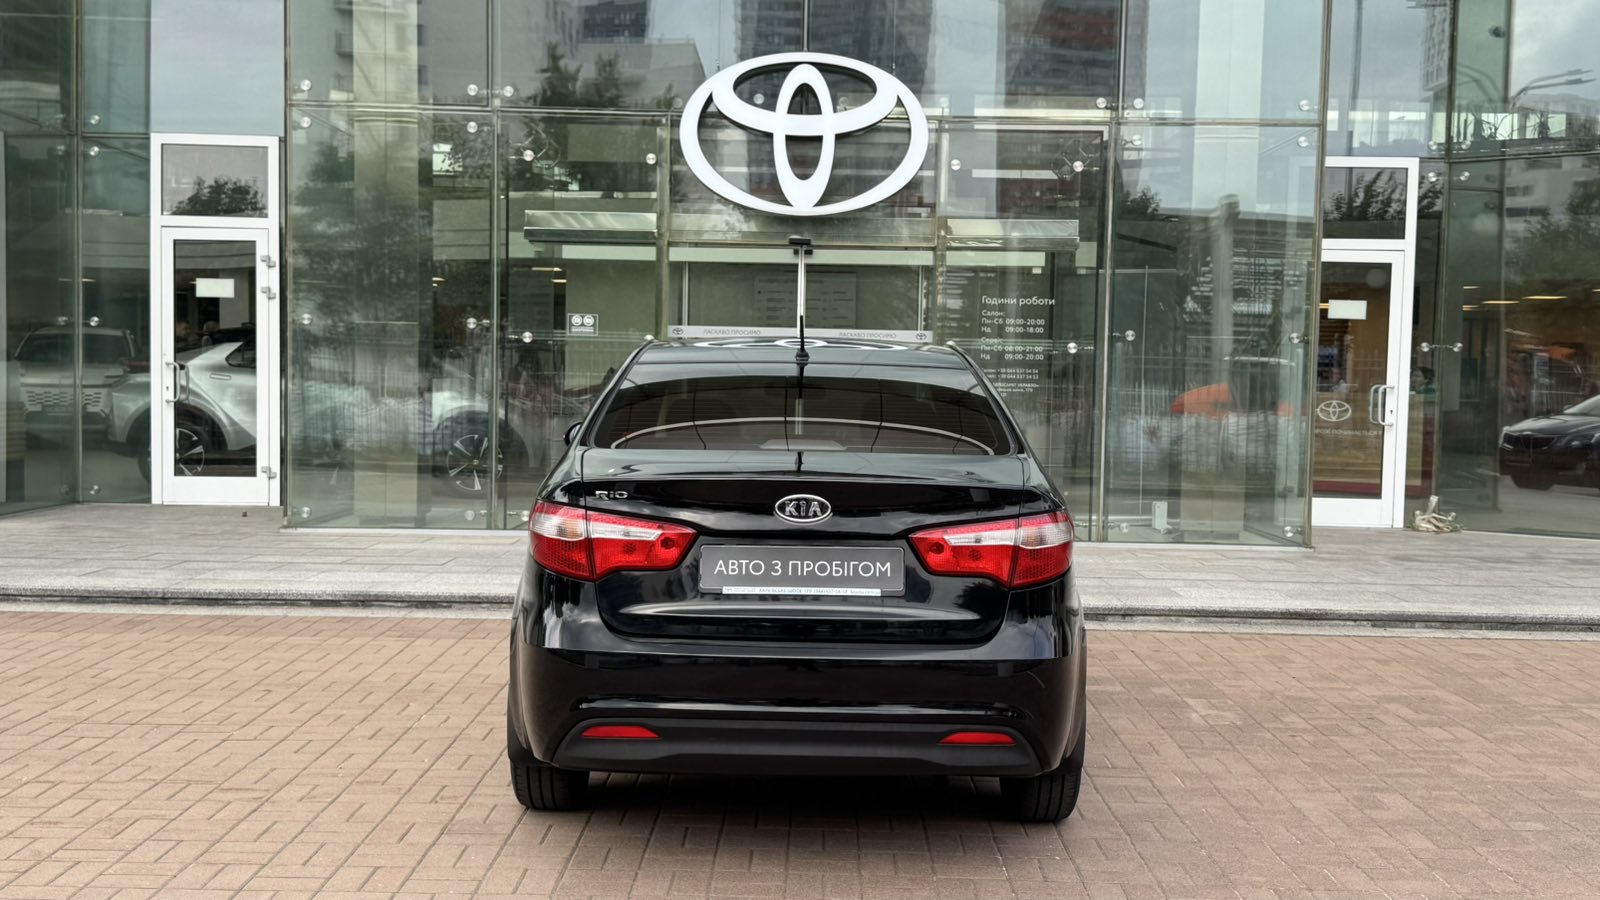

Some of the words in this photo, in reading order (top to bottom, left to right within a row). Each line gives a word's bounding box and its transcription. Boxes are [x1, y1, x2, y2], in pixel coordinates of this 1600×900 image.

[982, 295, 1017, 306] Години
[1019, 296, 1056, 307] роботи
[981, 309, 1005, 317] Салон:
[1005, 318, 1045, 326] 09:00-20:00
[1005, 326, 1044, 334] 09:00-18:00
[1004, 345, 1044, 353] 08:00-21:00
[1004, 353, 1044, 361] 09:00-20:00
[784, 500, 822, 516] KIA
[713, 559, 765, 576] АВТО
[770, 560, 782, 576] З
[789, 560, 891, 577] ПРОБІГОМ
